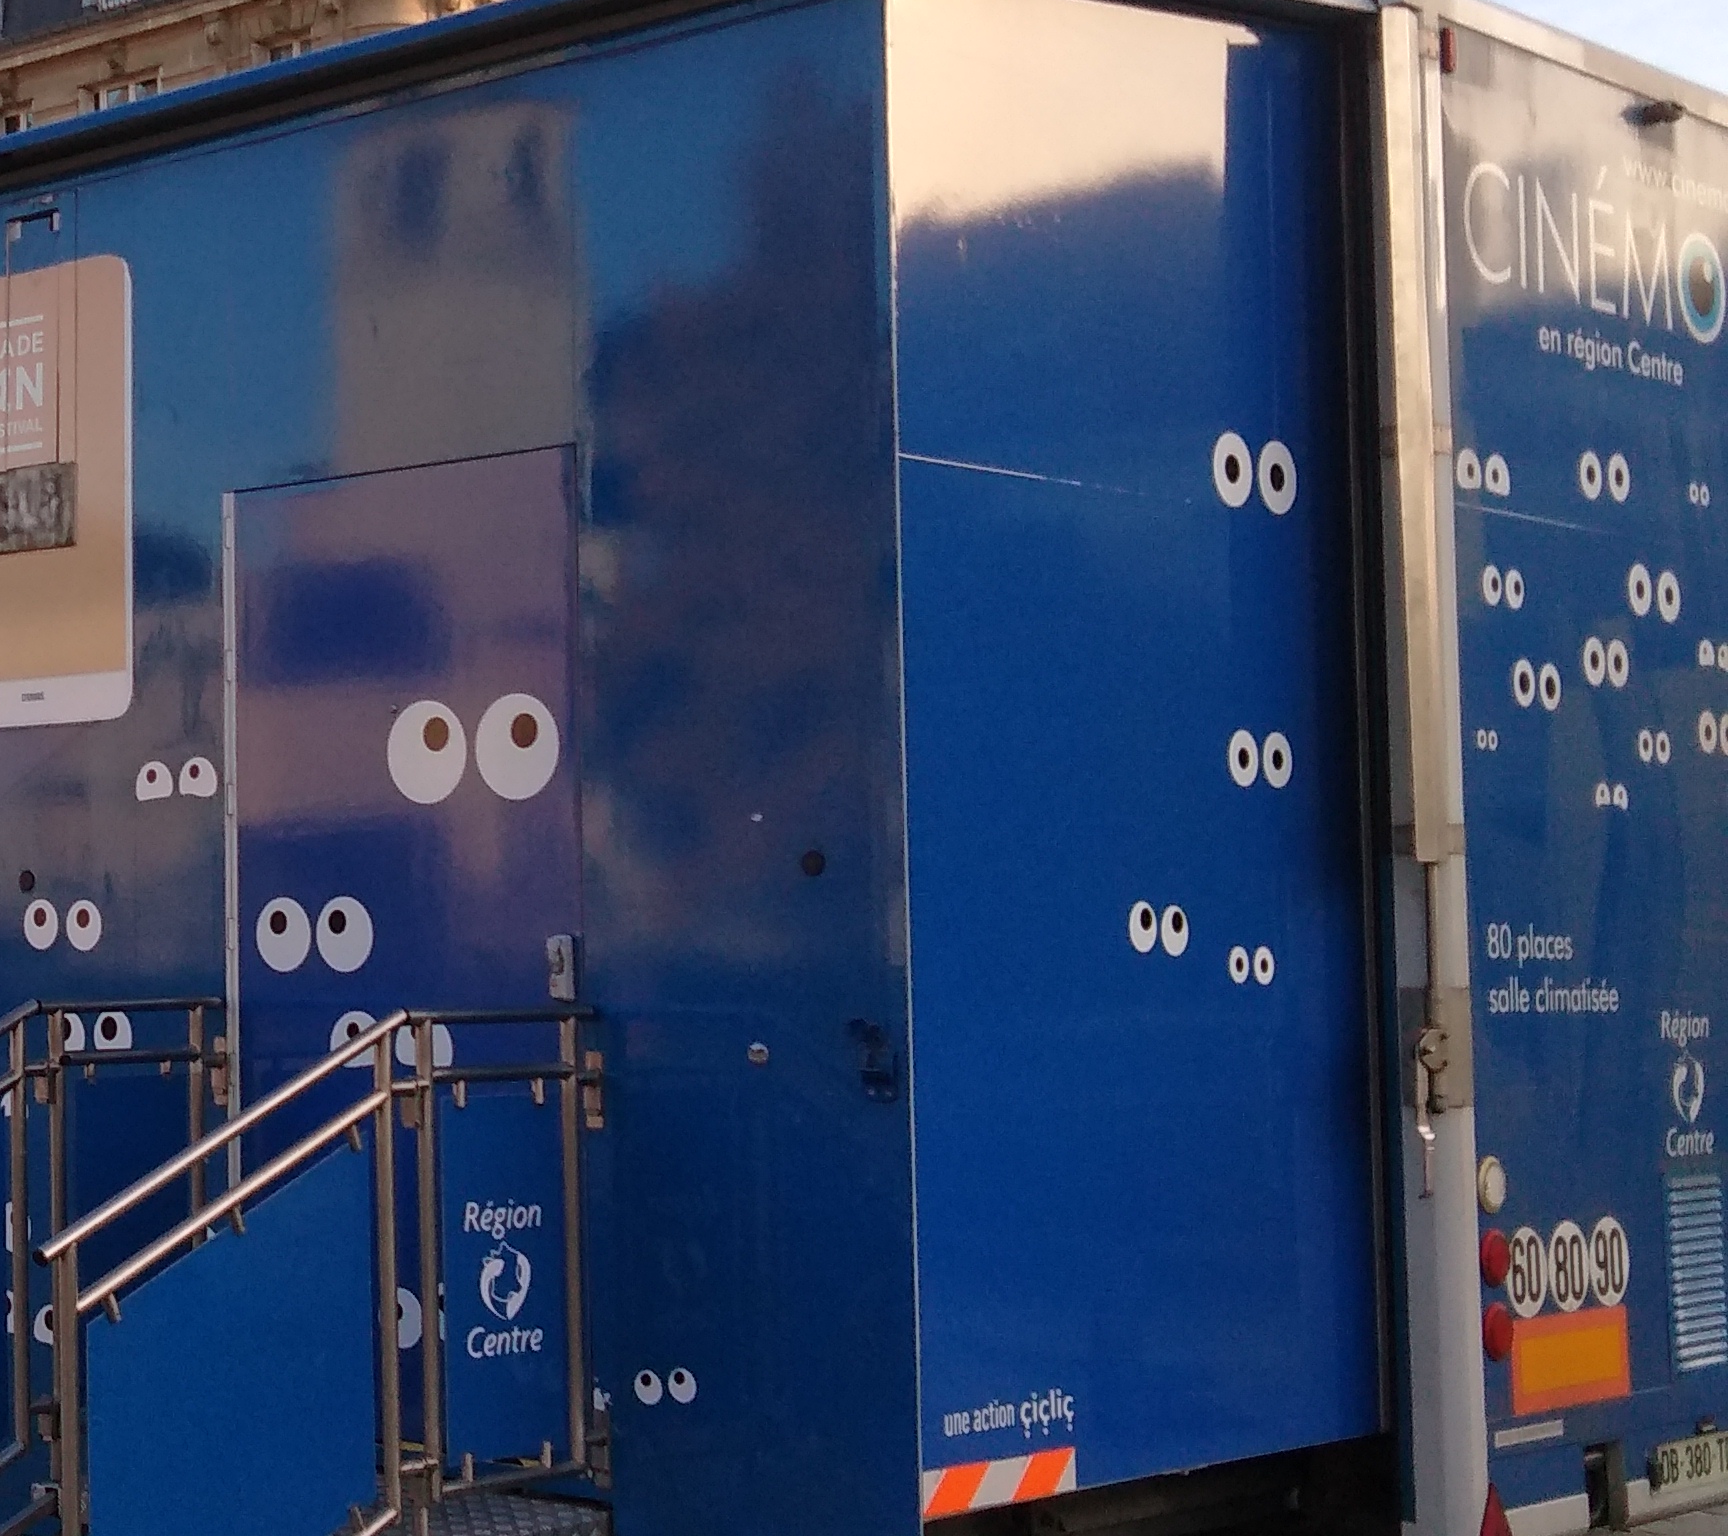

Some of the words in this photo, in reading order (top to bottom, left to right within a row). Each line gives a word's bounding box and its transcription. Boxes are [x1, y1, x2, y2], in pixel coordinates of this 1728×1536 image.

[17, 331, 43, 356] DE
[1539, 326, 1561, 354] en
[1567, 327, 1622, 371] région
[1628, 339, 1683, 386] Centre
[1487, 922, 1511, 959] 80
[1518, 923, 1573, 967] places
[1489, 976, 1530, 1014] salle
[1535, 976, 1619, 1013] climatisée
[1660, 1011, 1710, 1047] Région
[1666, 1127, 1714, 1157] Centre
[463, 1198, 543, 1240] Région
[1511, 1235, 1541, 1304] 60
[1554, 1234, 1584, 1301] 80
[1594, 1227, 1626, 1297] 90
[467, 1326, 543, 1359] Centre
[944, 1412, 970, 1437] une
[973, 1399, 1015, 1433] action
